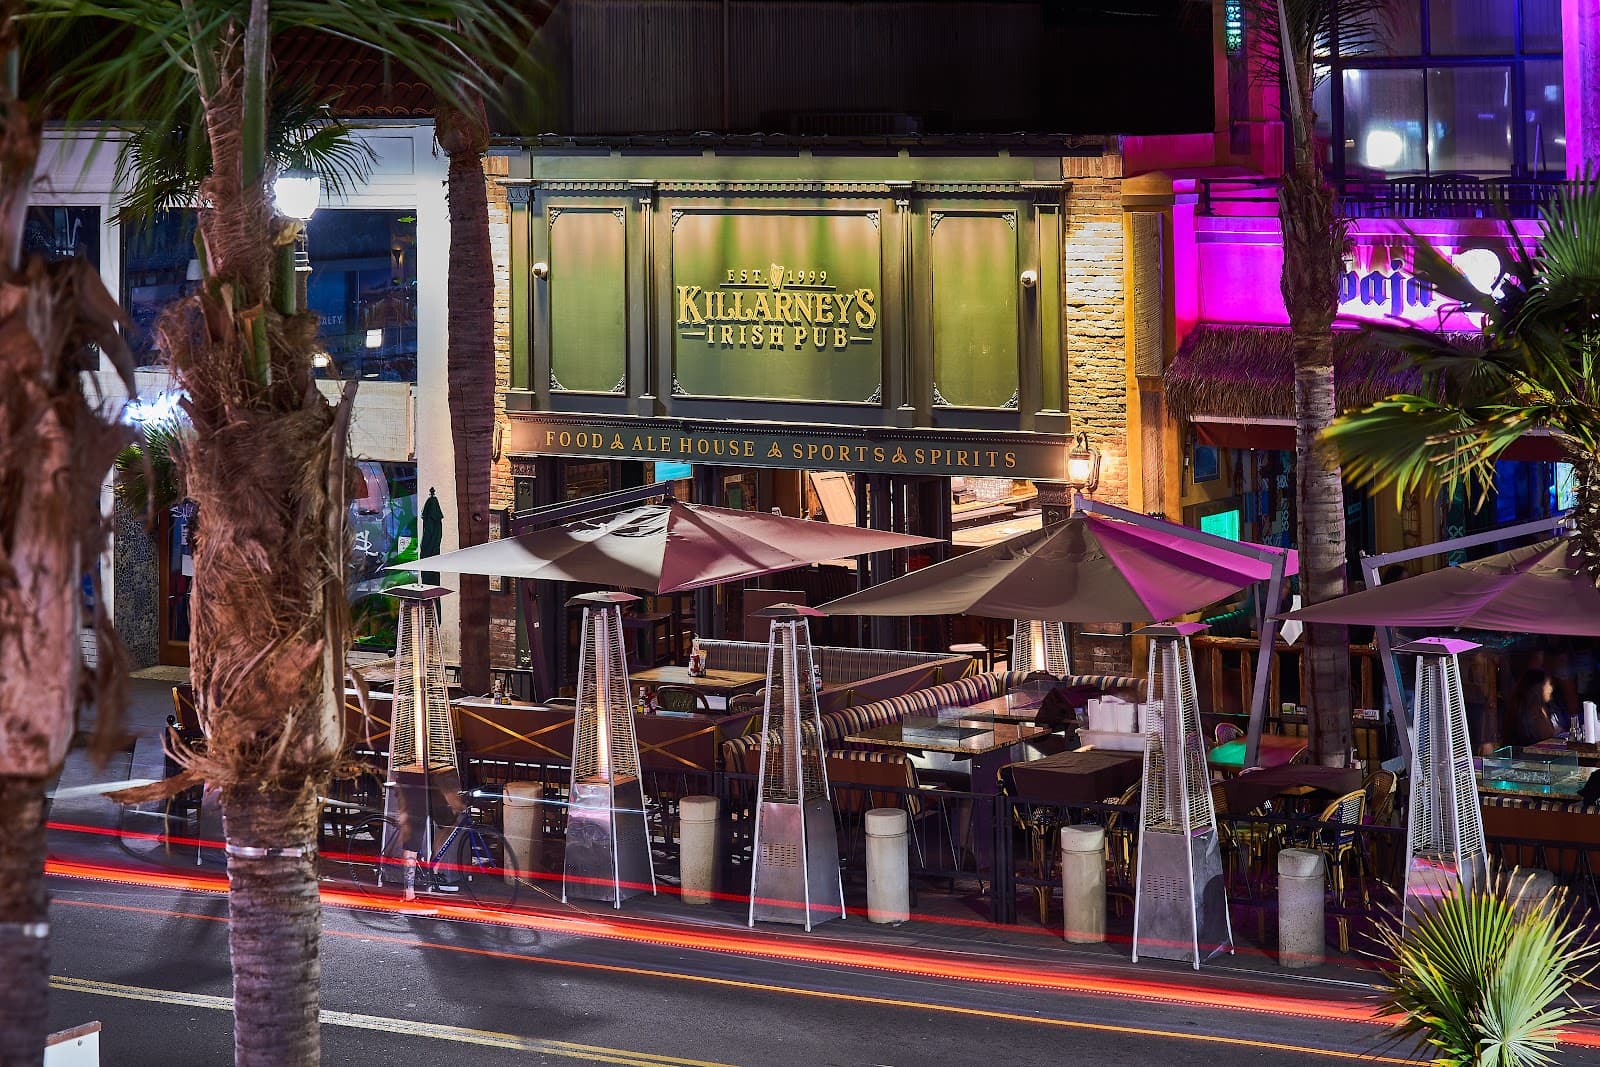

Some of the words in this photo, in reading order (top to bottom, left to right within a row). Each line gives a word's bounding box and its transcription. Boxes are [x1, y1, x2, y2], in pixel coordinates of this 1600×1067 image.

[727, 269, 767, 282] EST.
[788, 271, 827, 284] 1999
[706, 325, 784, 346] IRISH
[794, 326, 848, 349] PUB
[545, 431, 603, 449] FOOD
[632, 436, 671, 452] ALE
[679, 437, 755, 457] HOUSE
[792, 443, 885, 463] SPORTS
[915, 448, 1016, 469] SPIRITS
